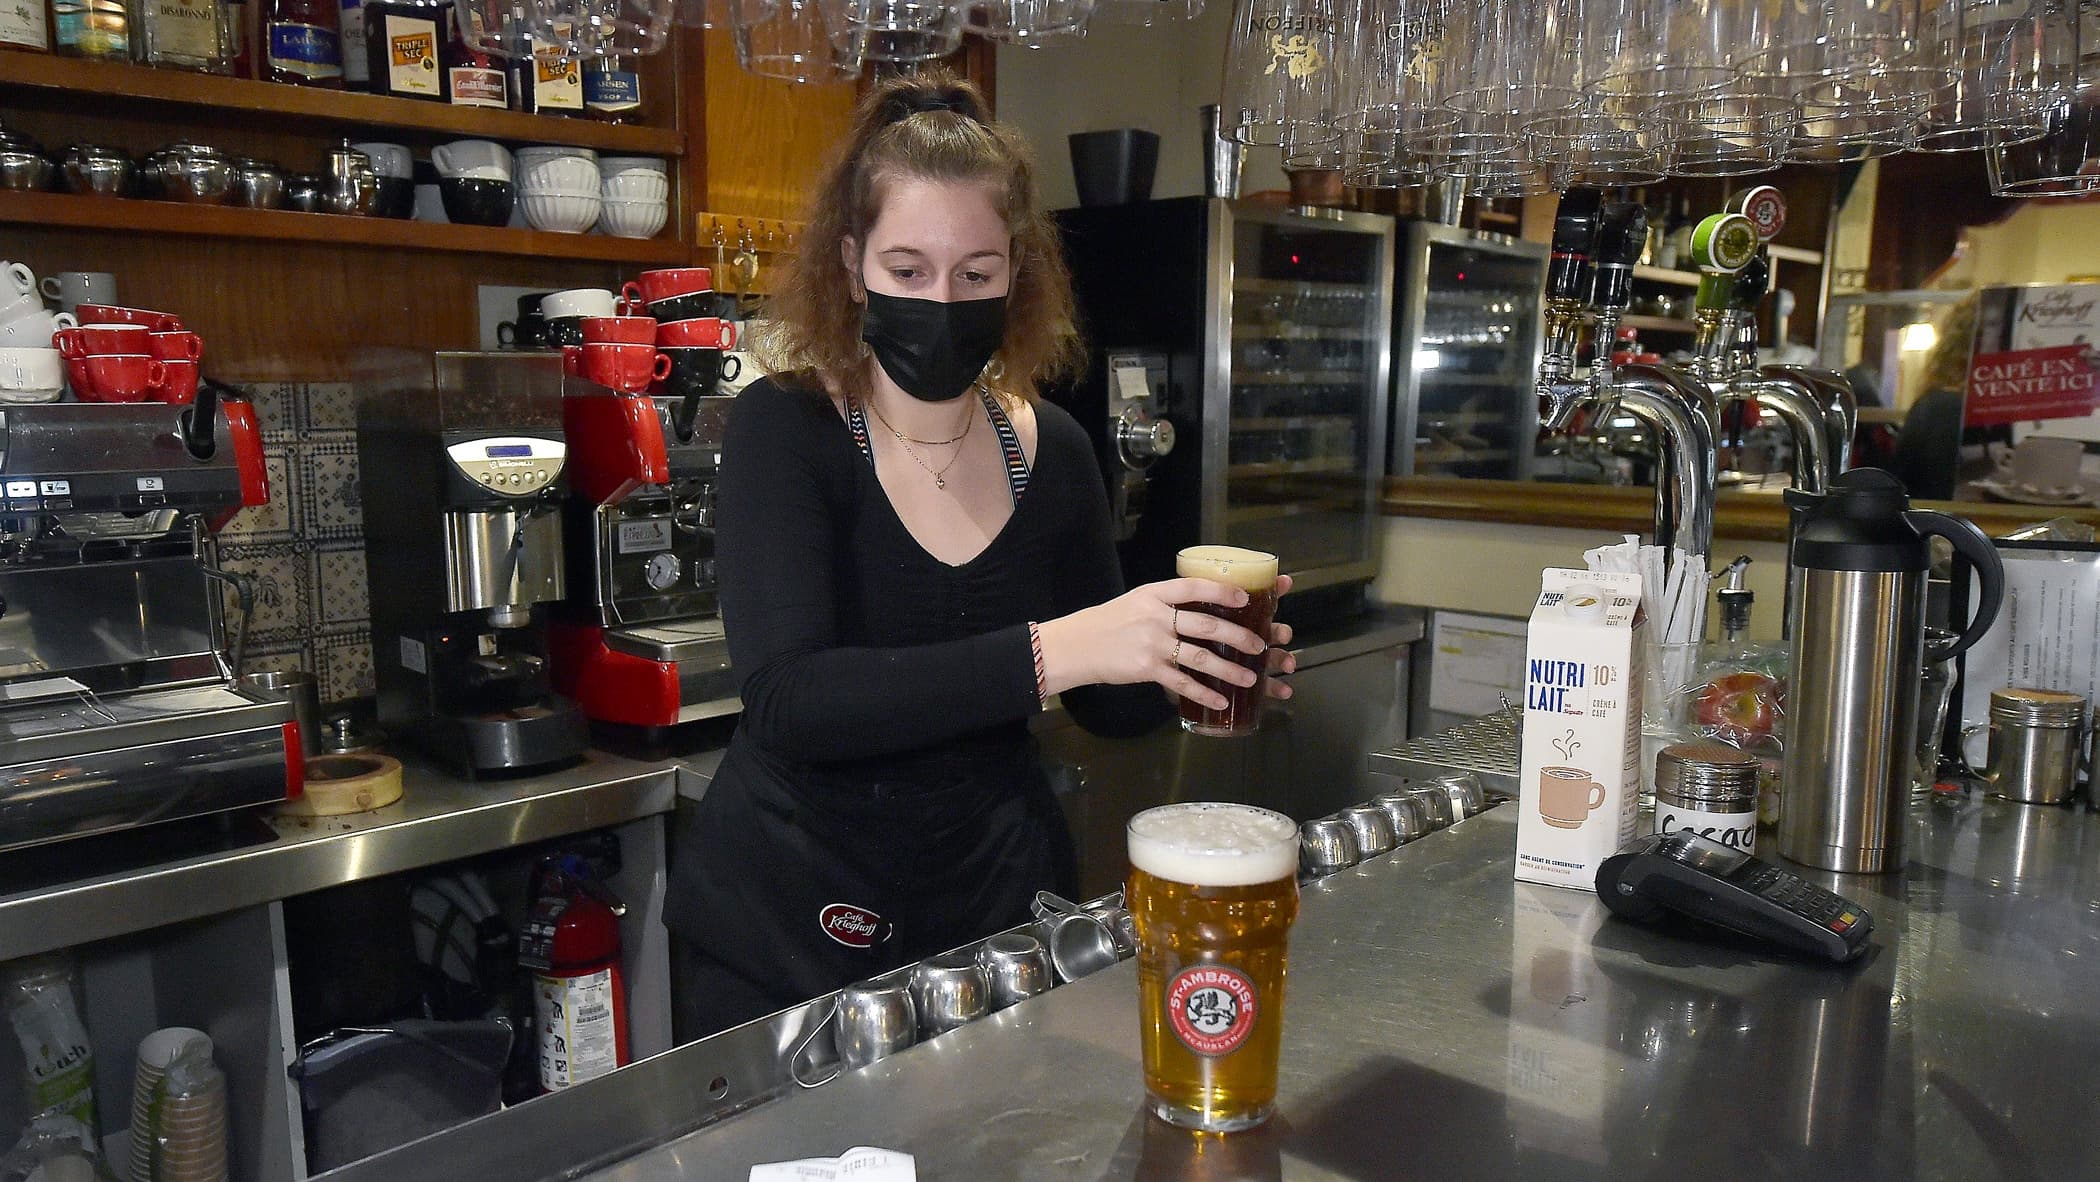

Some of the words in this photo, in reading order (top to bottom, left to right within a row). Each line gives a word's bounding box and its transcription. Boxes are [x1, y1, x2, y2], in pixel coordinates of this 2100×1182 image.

[161, 5, 211, 20] DISARONNO
[396, 39, 427, 50] TRIPLE
[405, 48, 422, 58] SEC
[548, 65, 567, 75] SEC
[1973, 358, 2035, 381] CAFÉ
[2041, 359, 2075, 376] EN
[1973, 377, 2053, 397] VENTE
[2060, 373, 2094, 391] ICI
[1540, 599, 1560, 607] LAIT
[1612, 597, 1626, 607] 10
[1530, 658, 1585, 688] NUTRI
[1593, 665, 1610, 686] 10
[1528, 684, 1566, 713] LAIT
[844, 911, 865, 923] Café
[828, 914, 878, 937] Krieghoff
